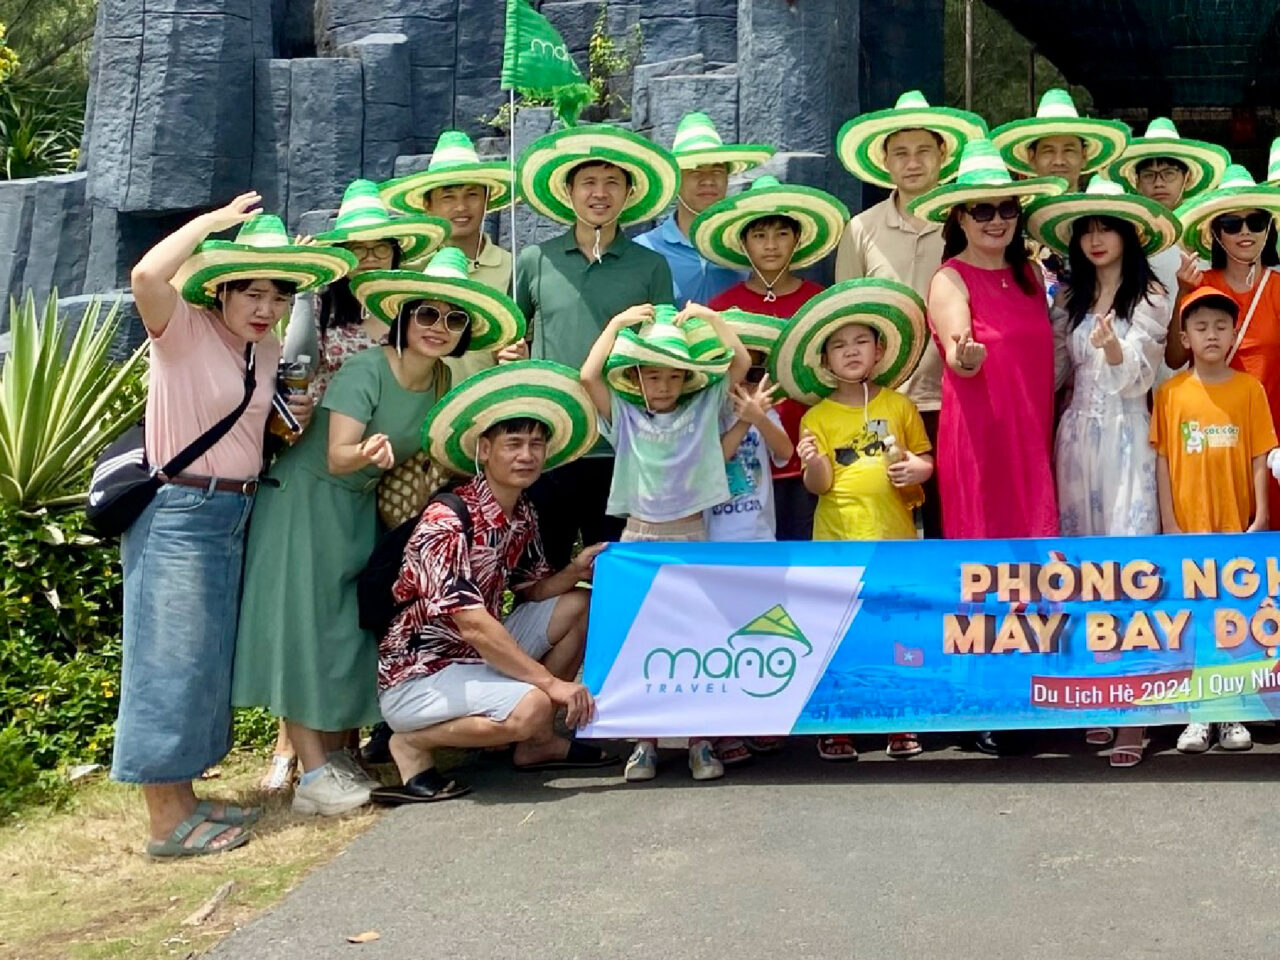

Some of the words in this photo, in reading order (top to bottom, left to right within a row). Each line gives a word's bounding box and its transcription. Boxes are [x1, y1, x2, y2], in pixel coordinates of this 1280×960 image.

[960, 551, 1162, 602] PHÒNG
[943, 602, 1068, 654] MÁY
[1086, 609, 1192, 652] BAY
[644, 647, 796, 697] mang
[646, 683, 727, 693] TRAVEL
[1034, 684, 1058, 702] Du
[1065, 685, 1102, 707] Lịch
[1110, 685, 1134, 703] Hè
[1141, 680, 1191, 701] 2024
[1209, 673, 1244, 695] Quy
